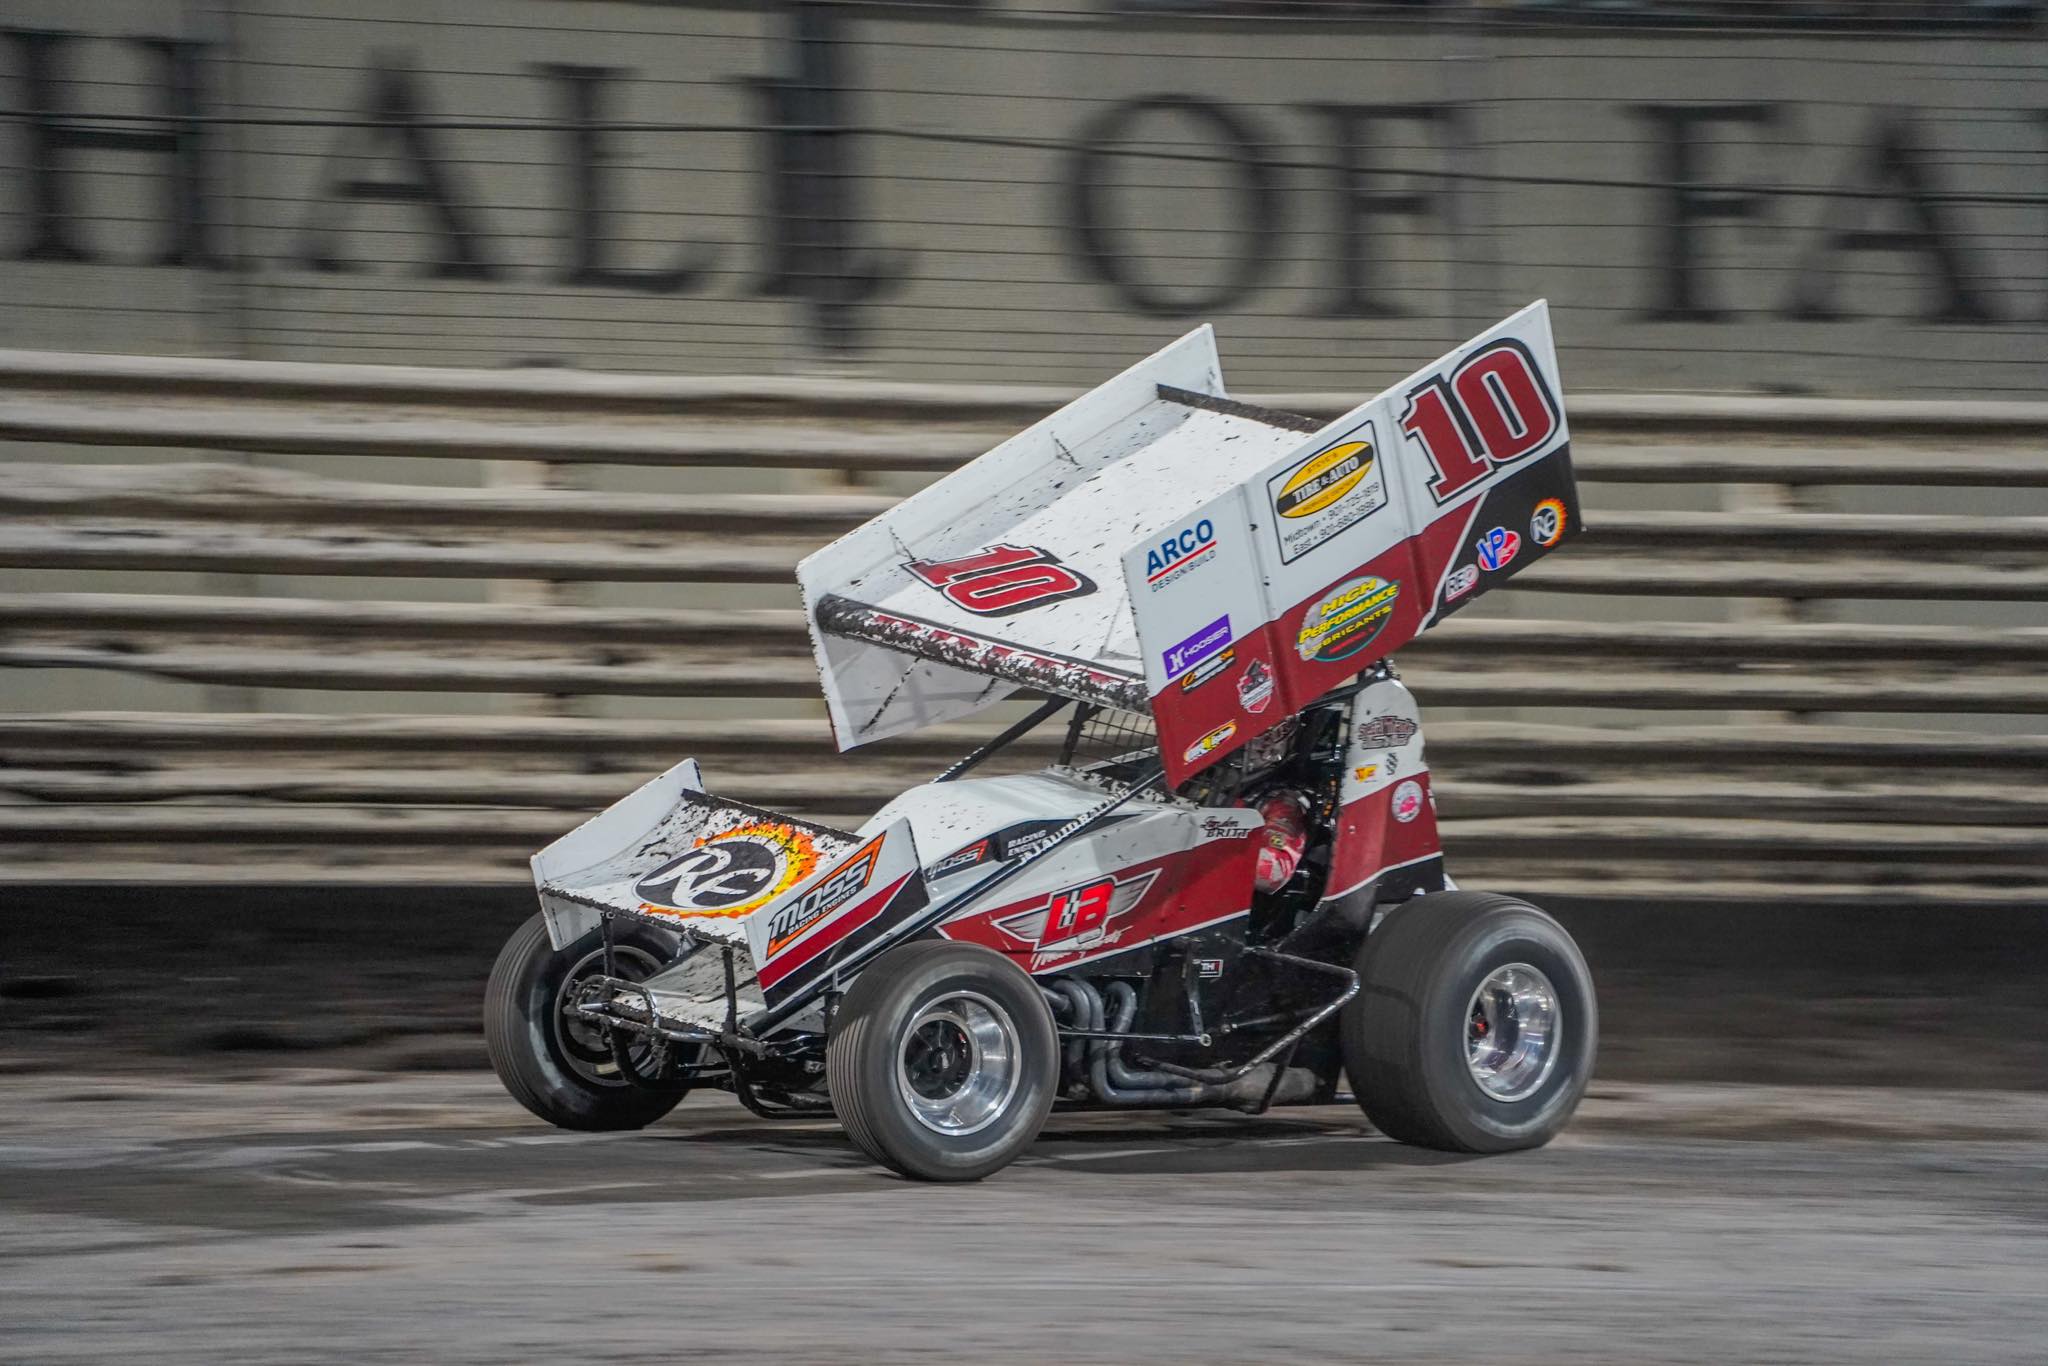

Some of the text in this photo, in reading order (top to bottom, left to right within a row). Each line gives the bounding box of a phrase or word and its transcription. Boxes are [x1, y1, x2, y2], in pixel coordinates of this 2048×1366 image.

[0, 28, 2048, 325] HALL OF FA
[1399, 337, 1560, 508] 10
[1292, 478, 1322, 503] TIRE
[1328, 456, 1360, 484] AUTO
[1147, 519, 1214, 576] ARCO
[1475, 526, 1507, 570] VP
[900, 542, 1097, 618] 10
[1320, 578, 1377, 617] HIGH
[1184, 626, 1229, 658] HOOSIER
[1298, 584, 1398, 645] PERFORMANCE
[1007, 829, 1047, 849] RACING
[638, 843, 771, 907] RC
[769, 854, 872, 939] MOSS
[787, 885, 858, 936] RACING ENGINES
